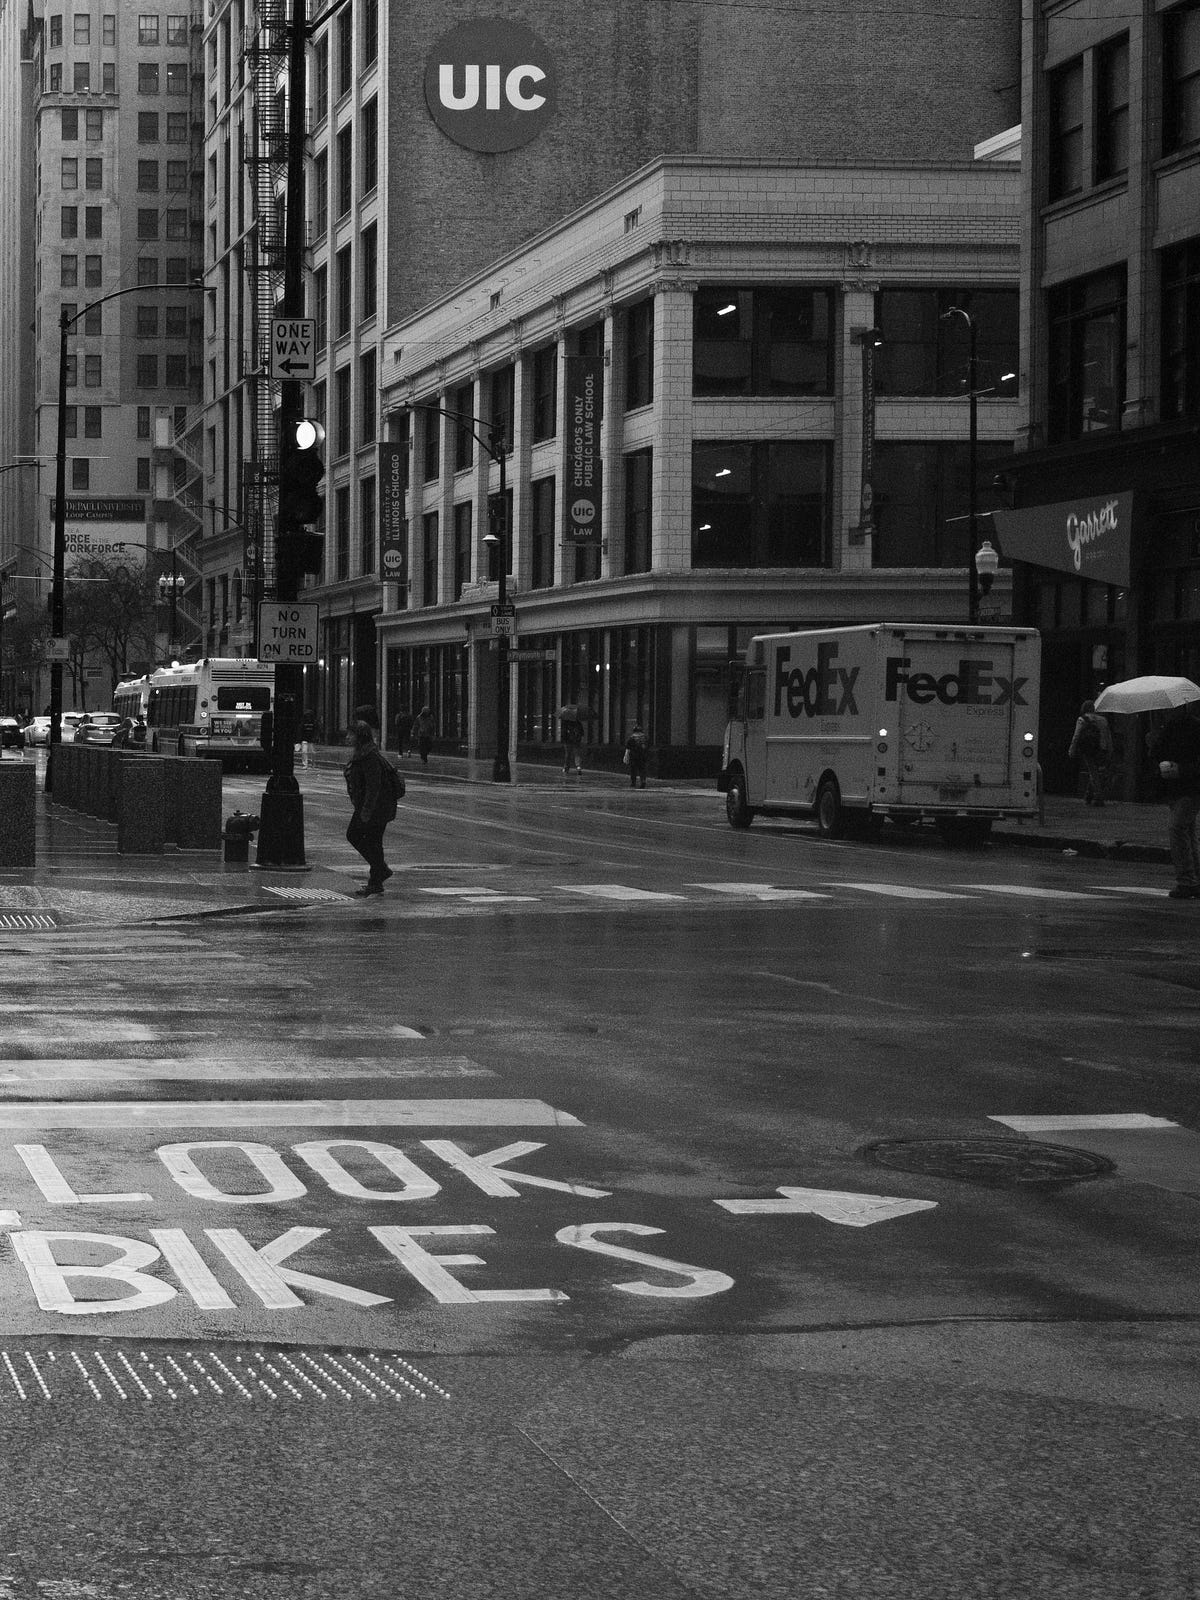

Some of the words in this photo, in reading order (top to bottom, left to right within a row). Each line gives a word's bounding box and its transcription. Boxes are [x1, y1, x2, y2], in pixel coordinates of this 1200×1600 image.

[439, 64, 546, 111] UIC
[276, 324, 310, 338] ONE
[276, 341, 311, 355] WAY
[574, 395, 584, 425] ONLY
[584, 373, 594, 420] SCHOOL
[584, 421, 594, 446] LAW
[574, 427, 584, 487] CHICAGO'S
[584, 447, 594, 487] PUBLIC
[391, 454, 400, 499] CHICAGO
[391, 501, 400, 541] ILLINOIS
[573, 507, 593, 517] UIC
[64, 534, 90, 543] ORCE
[573, 528, 593, 536] LAW
[1066, 500, 1119, 571] Garrett
[385, 555, 401, 563] UIC
[278, 610, 300, 622] NO
[272, 627, 306, 639] TURN
[495, 626, 511, 634] ONLY
[263, 644, 280, 655] ON
[288, 644, 313, 656] RED
[774, 641, 860, 718] FedEx
[885, 656, 1029, 705] FedEx
[966, 705, 1005, 717] Express
[14, 1140, 613, 1204] LOOK
[10, 1222, 735, 1315] BIKES
